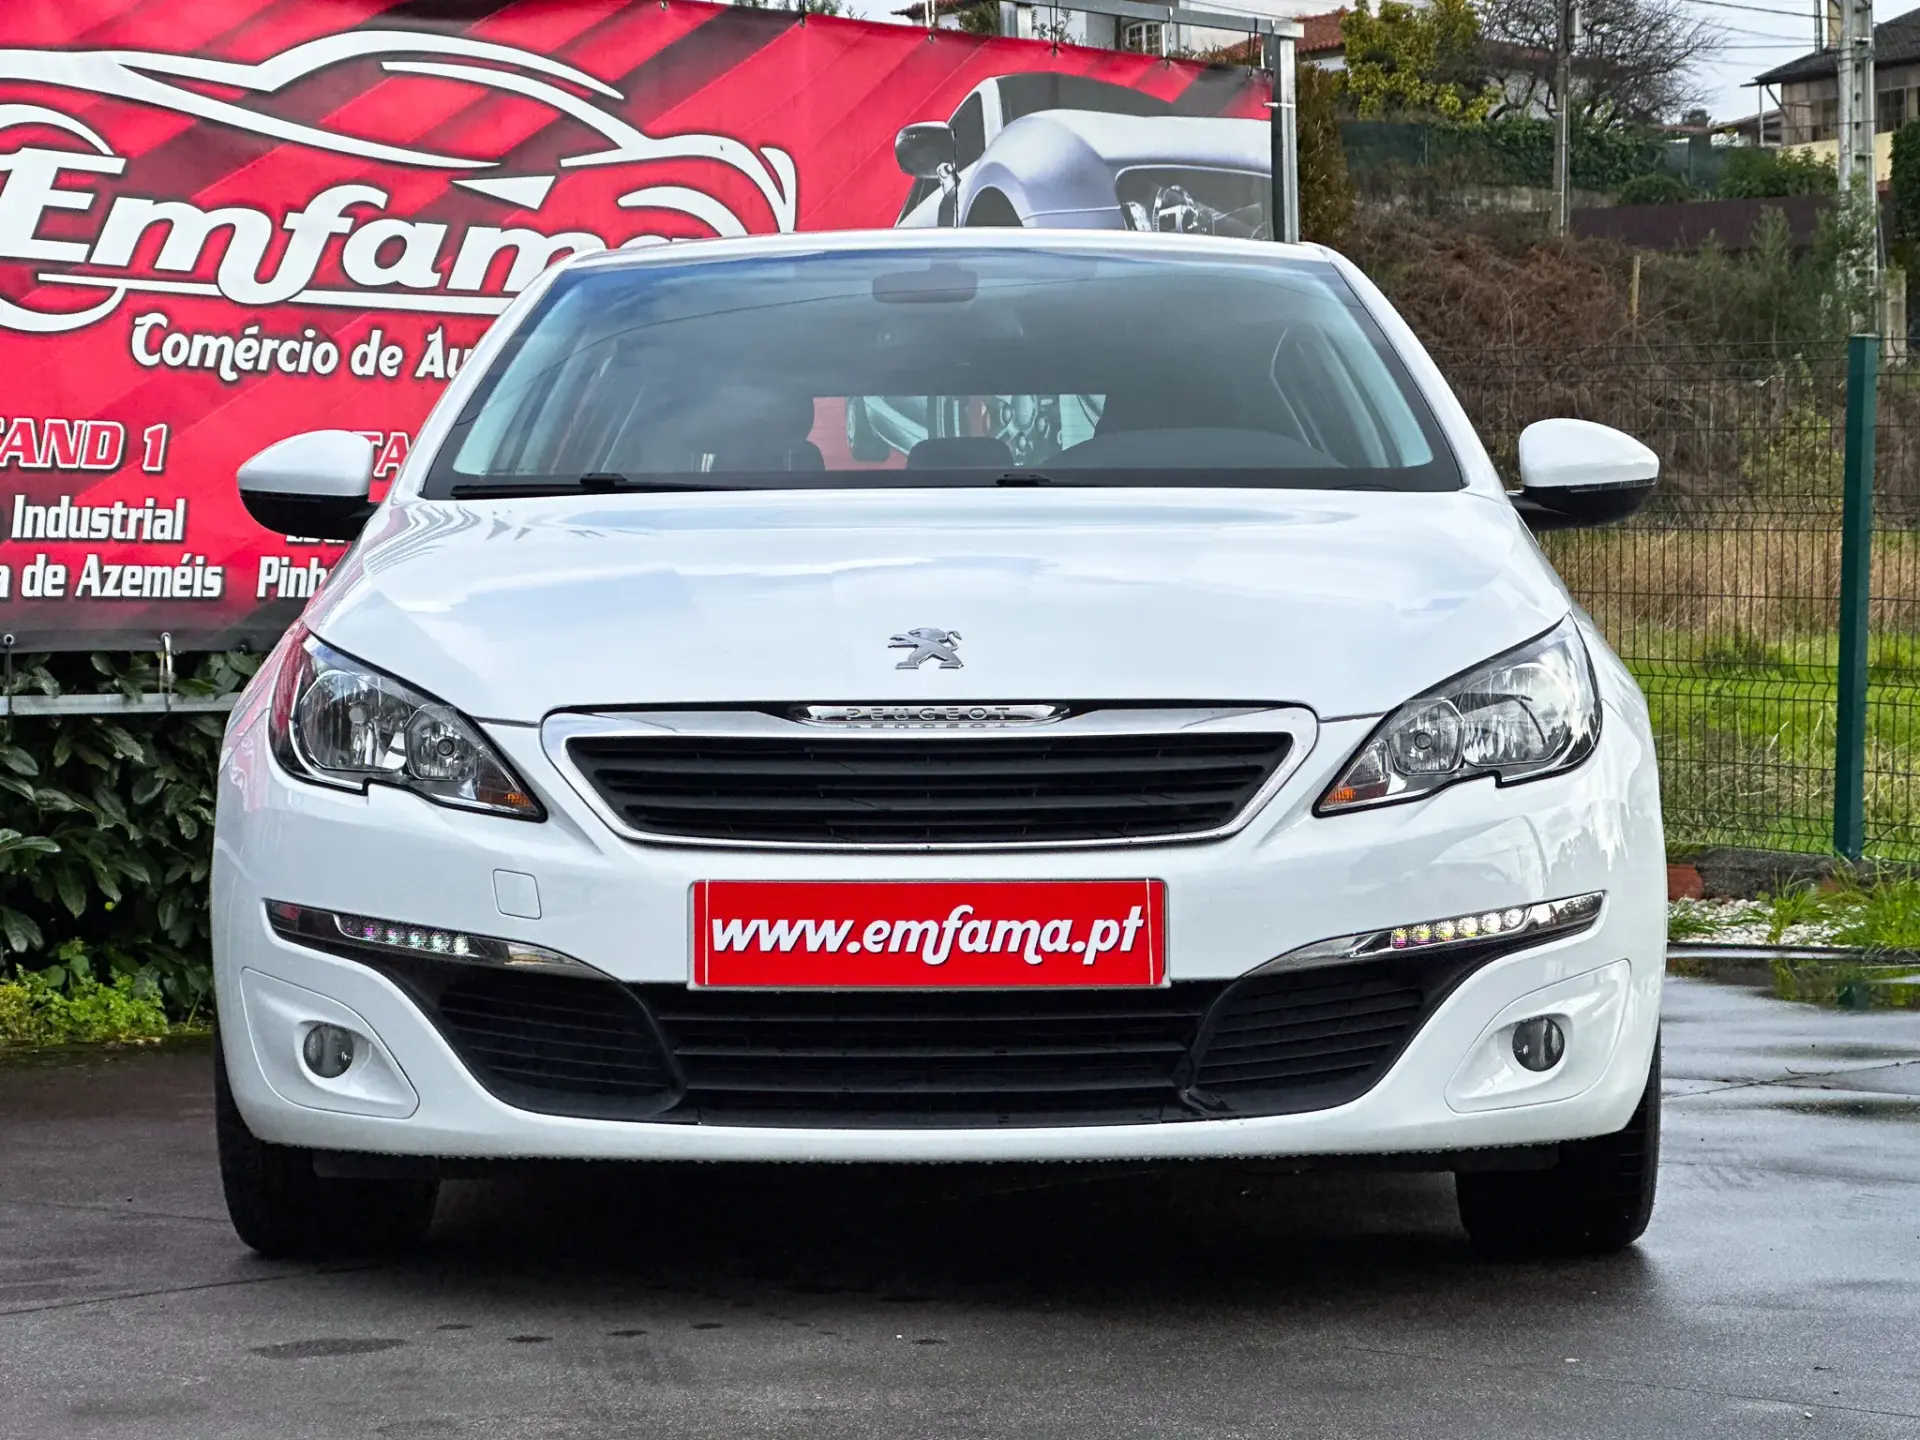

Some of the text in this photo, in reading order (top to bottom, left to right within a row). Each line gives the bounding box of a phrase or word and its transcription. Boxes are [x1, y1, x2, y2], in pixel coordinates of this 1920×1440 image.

[0, 147, 700, 304] Emfam
[132, 313, 339, 382] Comércio
[350, 329, 403, 377] de
[0, 417, 167, 471] AND 1
[11, 494, 186, 541] Industrial
[21, 553, 66, 598] de
[75, 553, 223, 598] Azeméis
[256, 555, 334, 598] Pinh
[846, 707, 1010, 720] PEUGEOT
[711, 904, 1144, 965] www.emfama.pt
